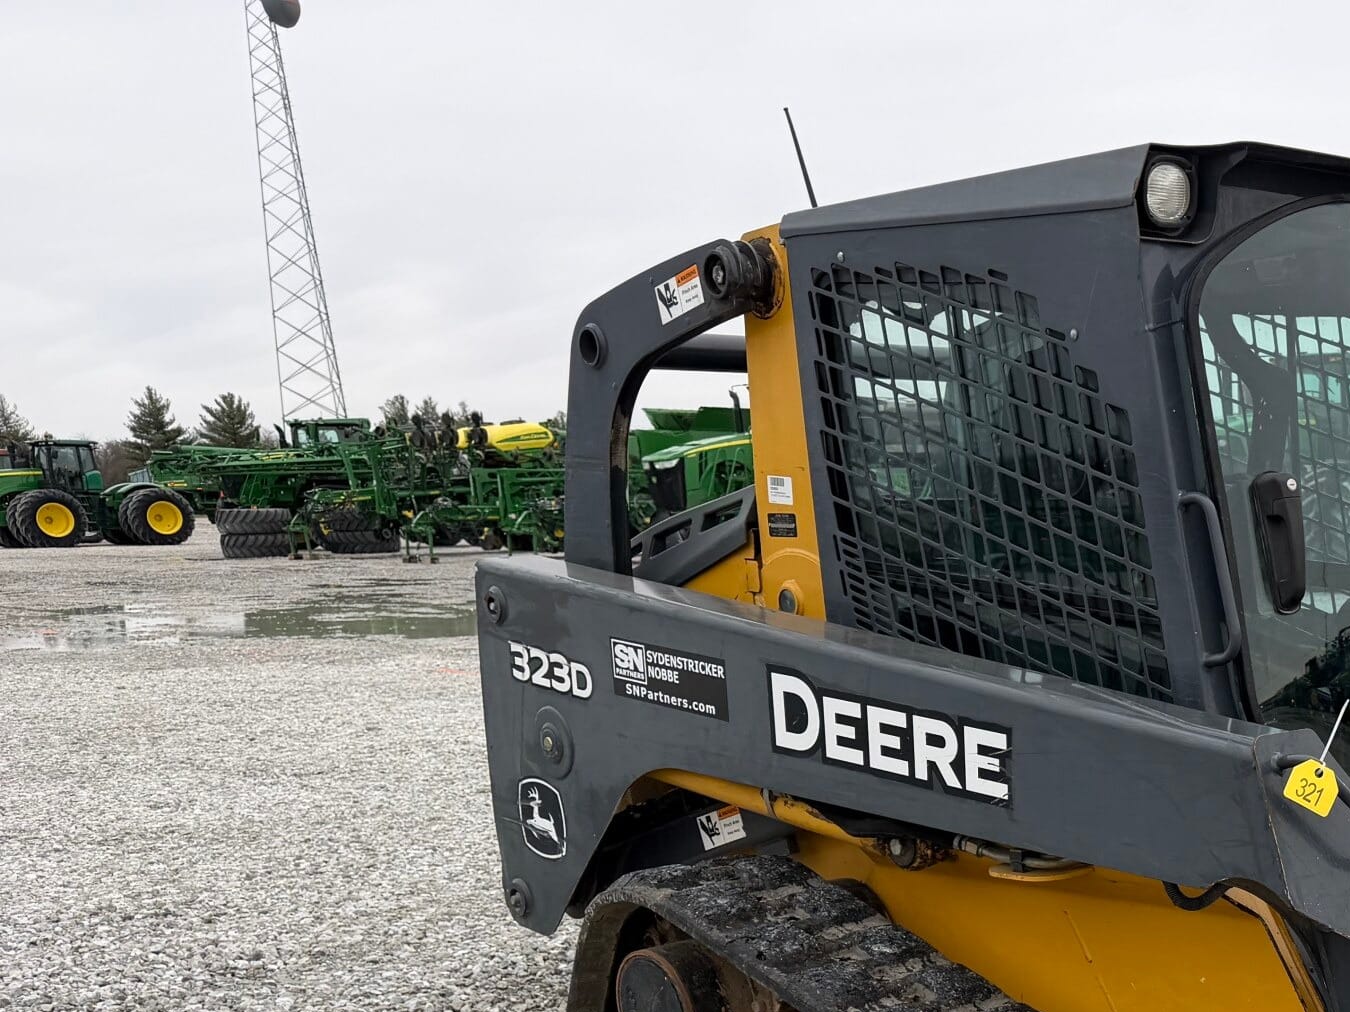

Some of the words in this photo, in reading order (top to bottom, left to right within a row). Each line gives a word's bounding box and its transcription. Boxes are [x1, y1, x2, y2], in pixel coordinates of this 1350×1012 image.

[508, 641, 592, 698] 323D
[614, 643, 645, 673] SN
[646, 650, 725, 679] SYDENSTRICKER
[615, 667, 645, 680] PARTNERS
[647, 665, 680, 684] NOBBE
[625, 683, 716, 715] SNPartners.com
[770, 671, 1009, 801] DEERE
[1295, 777, 1325, 807] 321
